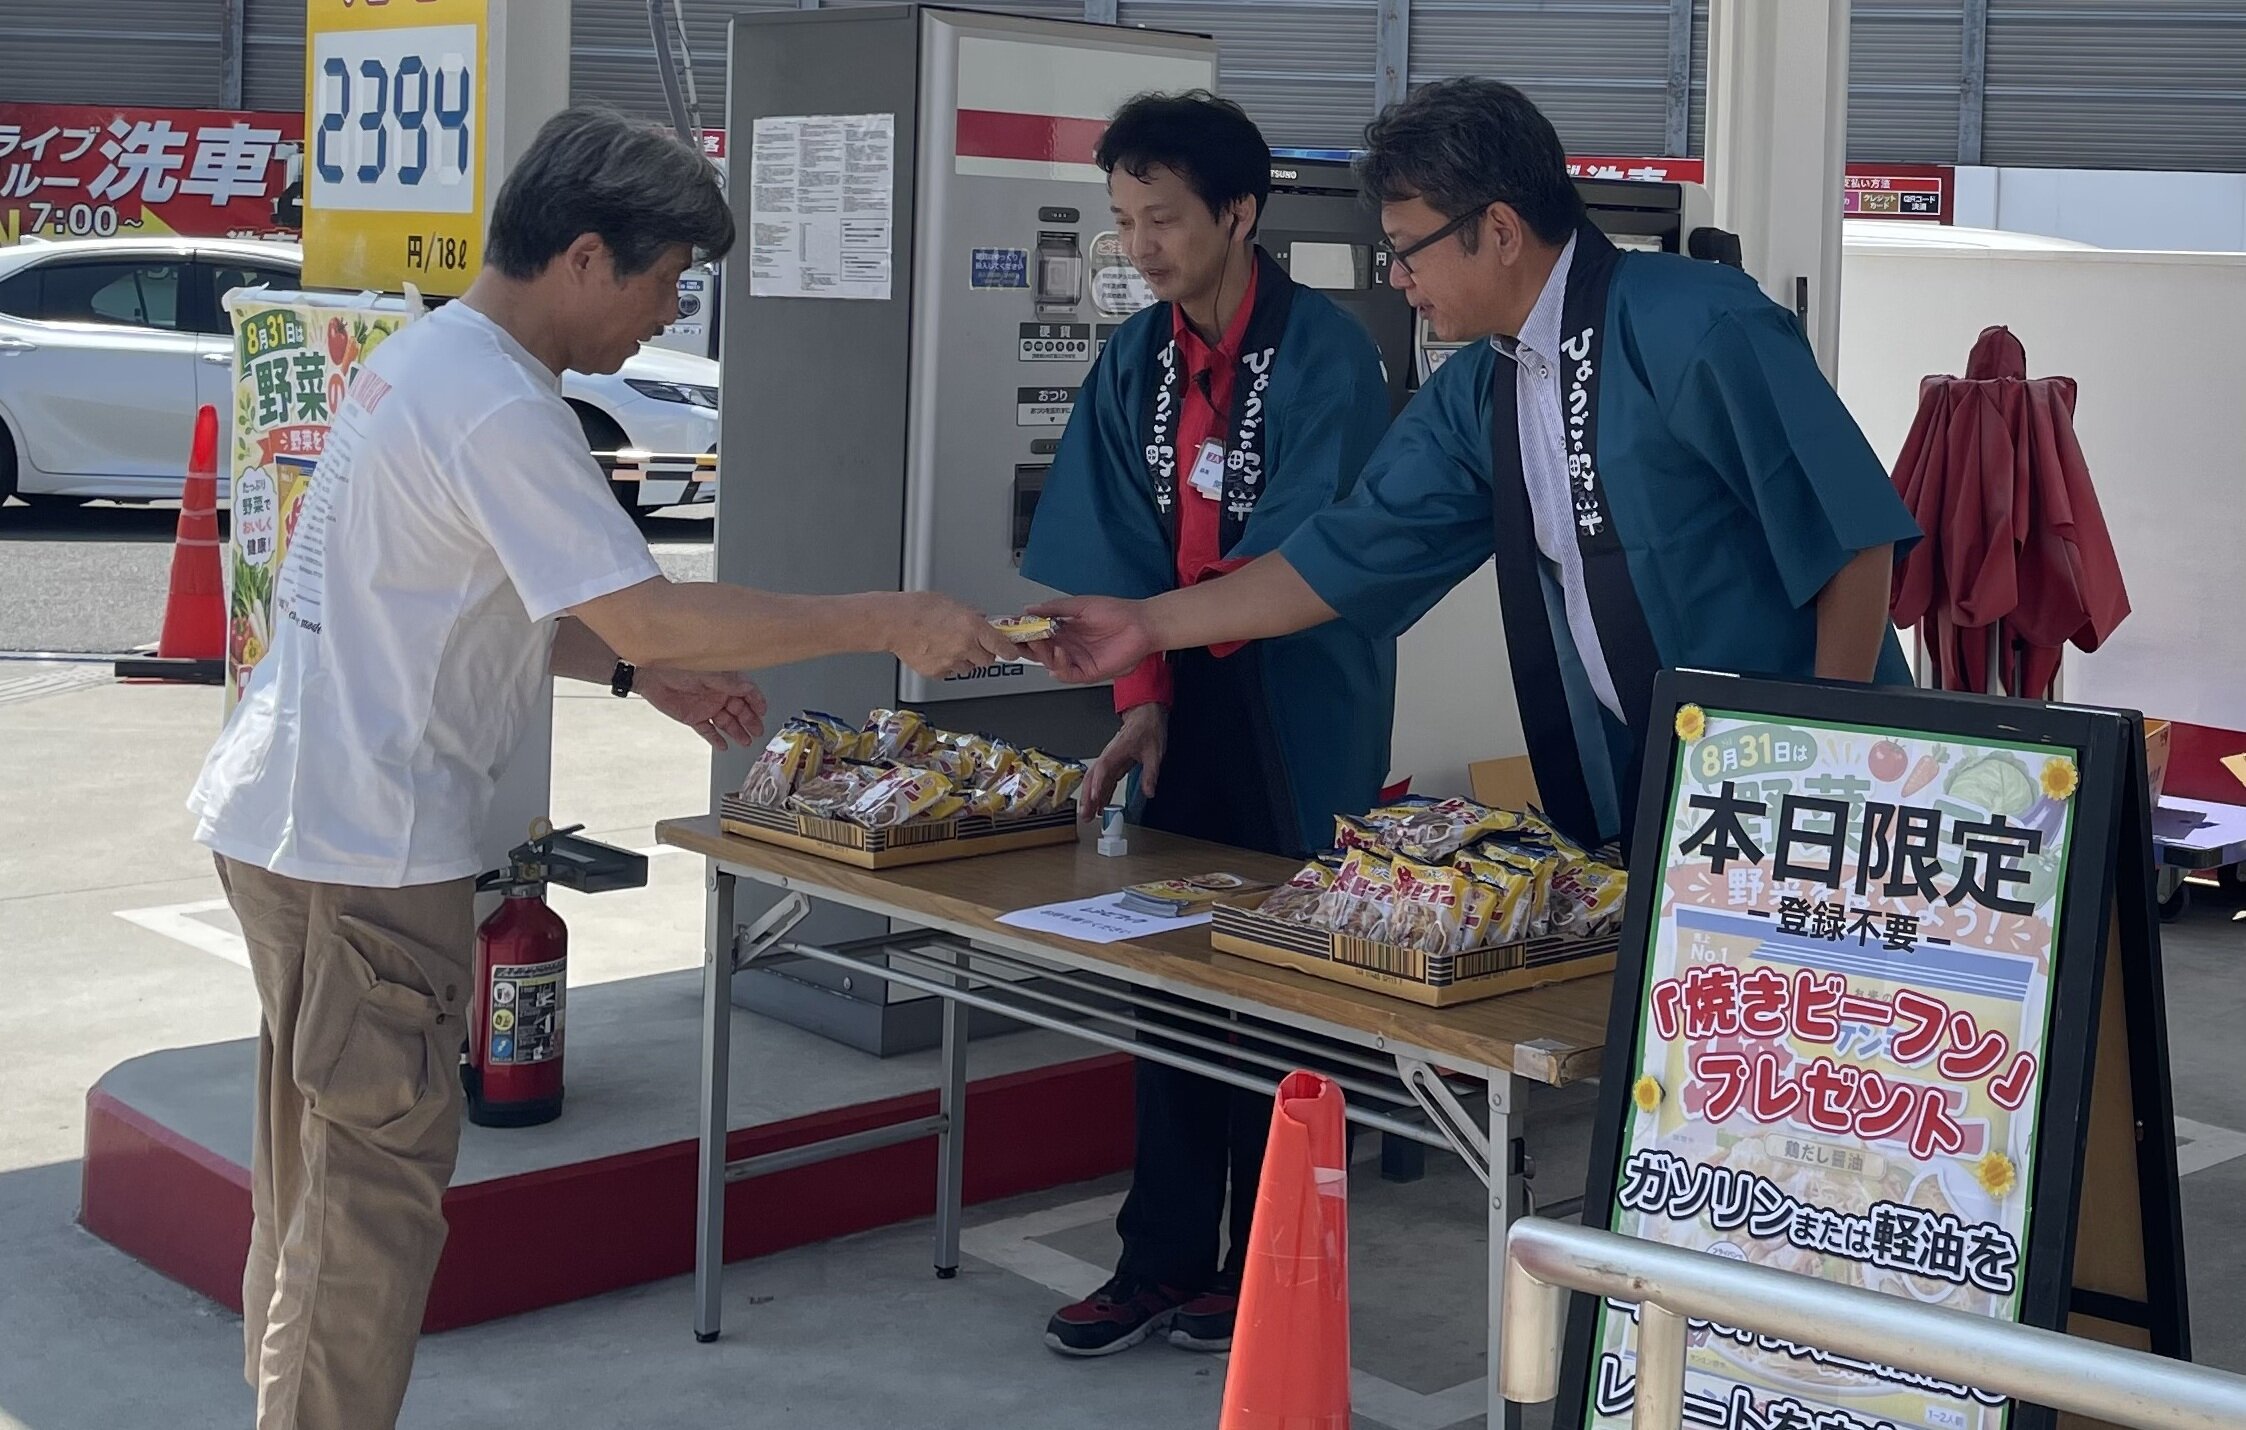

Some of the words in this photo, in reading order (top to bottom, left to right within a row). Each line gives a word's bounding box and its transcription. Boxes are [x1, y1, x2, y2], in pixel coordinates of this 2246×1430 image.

[317, 55, 470, 186] 2394
[87, 119, 282, 206] 洗車
[1376, 252, 1387, 266] 円
[247, 314, 305, 355] 8月31日は
[1038, 389, 1068, 402] おつり
[290, 430, 328, 452] 野菜を
[1702, 731, 1808, 777] 8月31日は
[1679, 780, 2043, 916] 本日限定
[1652, 966, 2037, 1112] 「焼きビーフン」
[1697, 1051, 1965, 1159] プレゼント
[1783, 1139, 1865, 1172] 鶏だし醤油
[1619, 1149, 2019, 1294] ガソリンまたは軽油を
